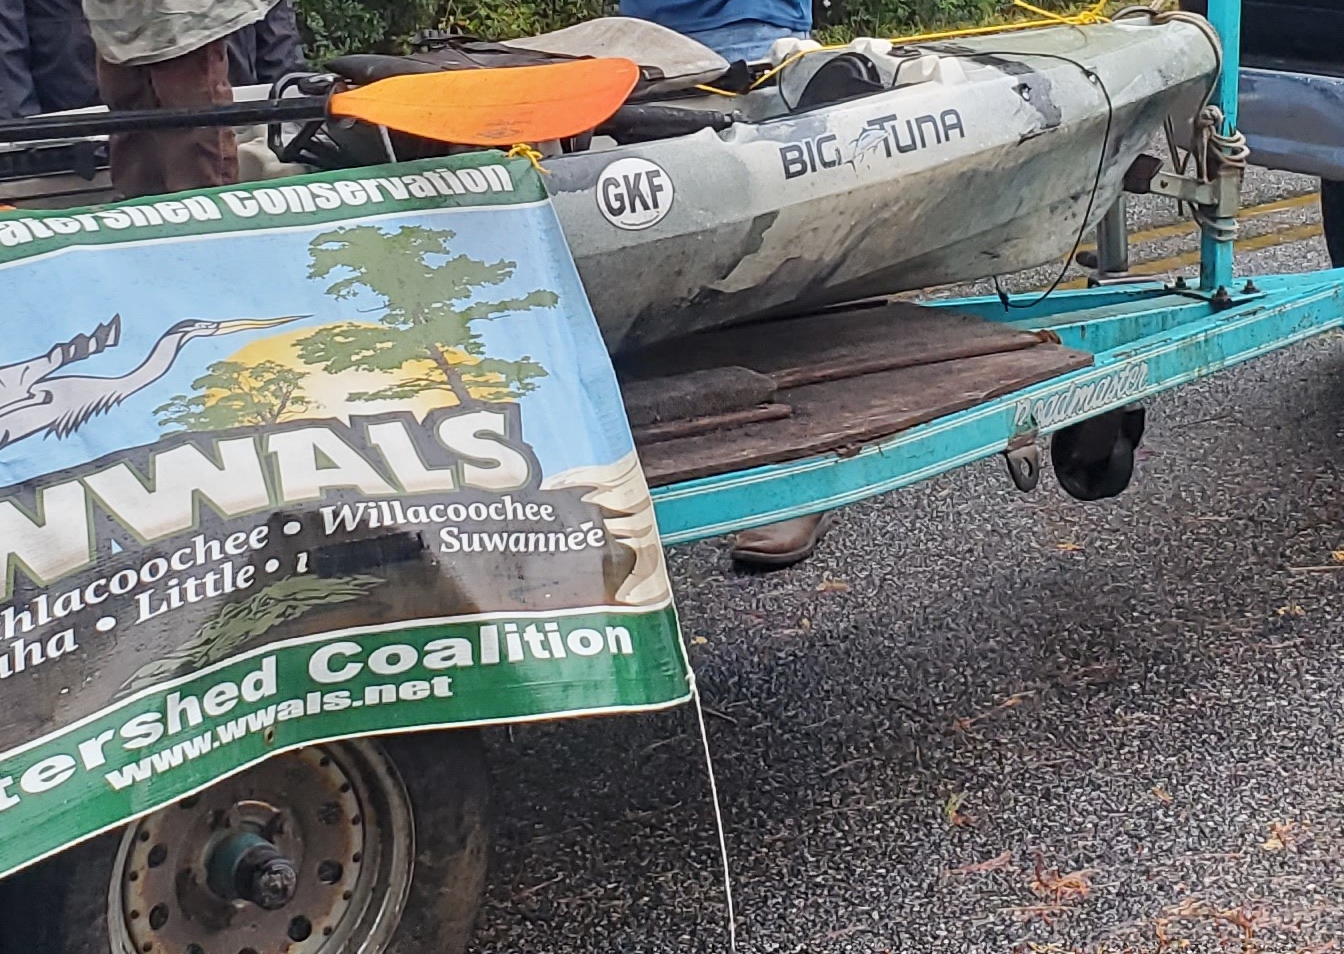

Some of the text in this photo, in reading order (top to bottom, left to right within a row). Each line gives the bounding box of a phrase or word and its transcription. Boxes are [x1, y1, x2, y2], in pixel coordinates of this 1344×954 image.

[779, 108, 965, 180] BIG TUNA
[222, 162, 514, 217] Conservation
[602, 169, 664, 217] GKF
[319, 495, 555, 536] Willacoochee
[439, 525, 605, 554] Suwannee
[134, 552, 256, 624] Little
[308, 620, 634, 685] Coalition
[104, 674, 454, 792] www.wwals.net
